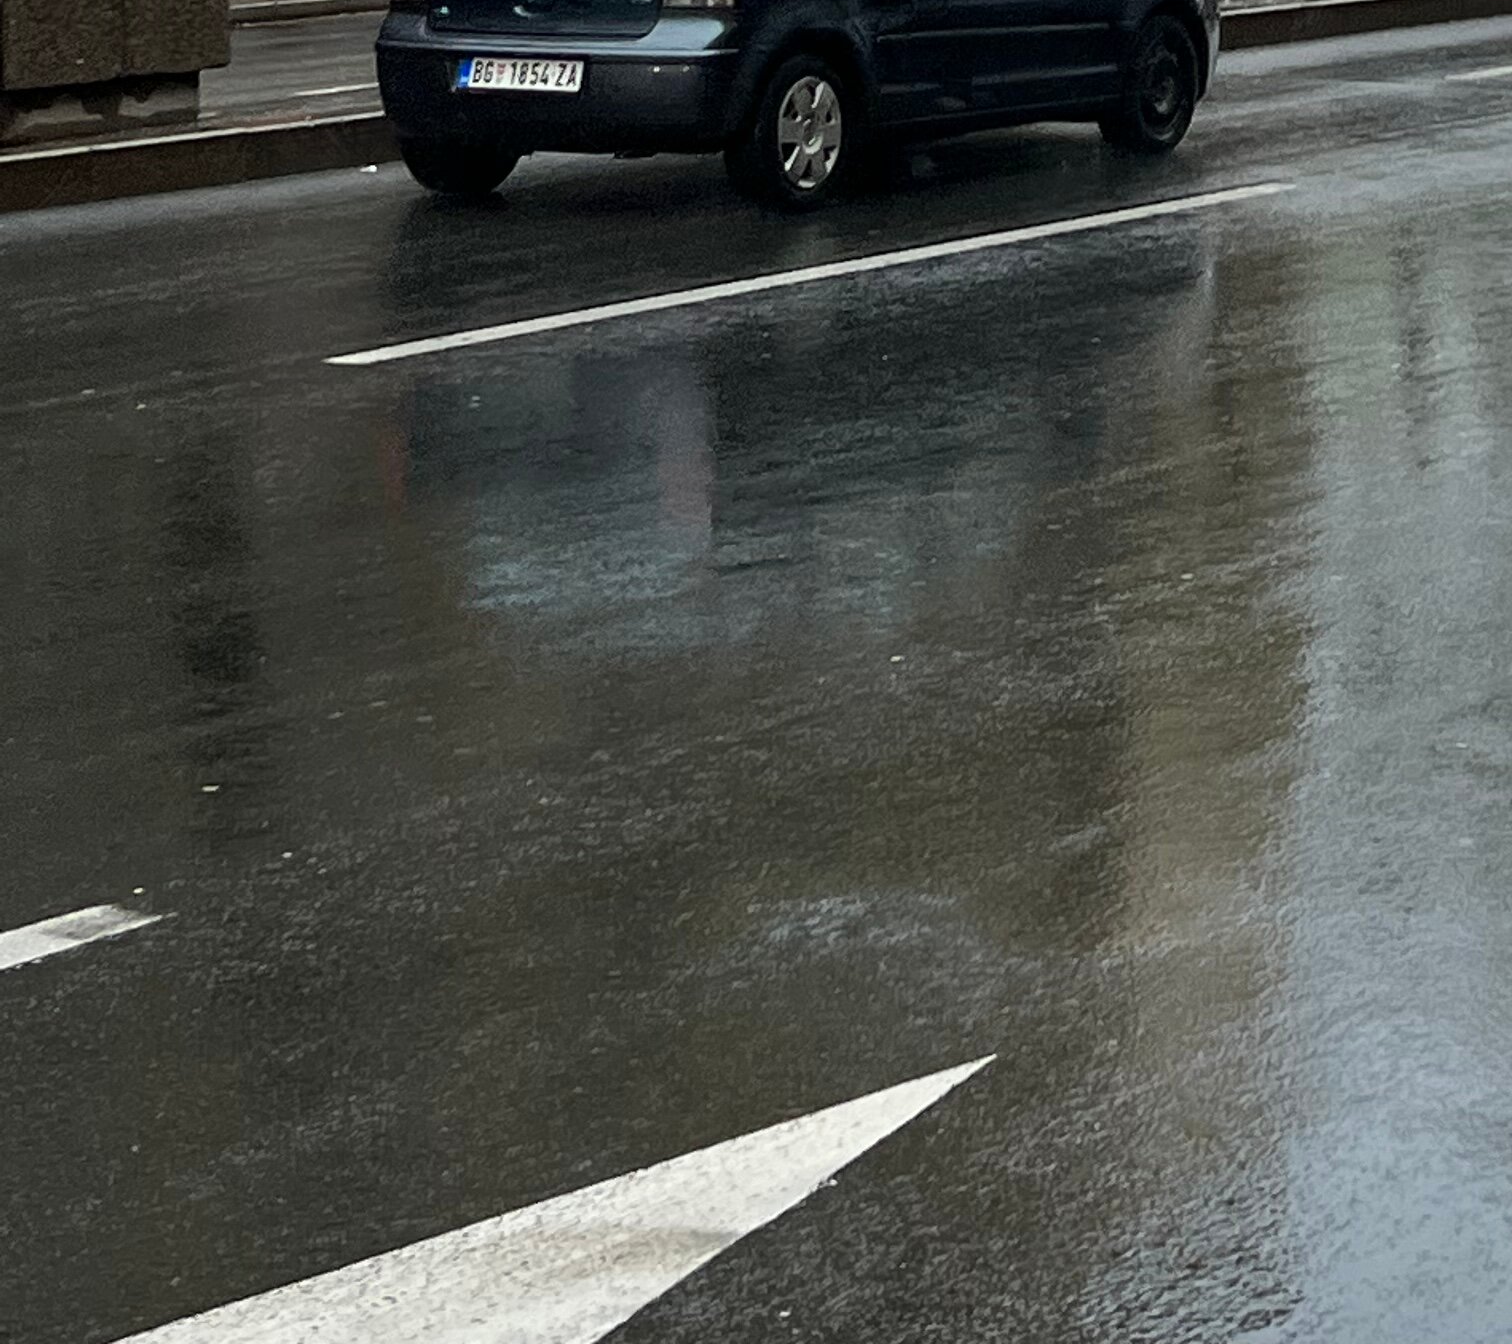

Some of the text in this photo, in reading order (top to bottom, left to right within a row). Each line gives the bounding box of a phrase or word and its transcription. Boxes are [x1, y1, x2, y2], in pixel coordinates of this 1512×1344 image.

[472, 60, 577, 87] BG 1854 ZA
